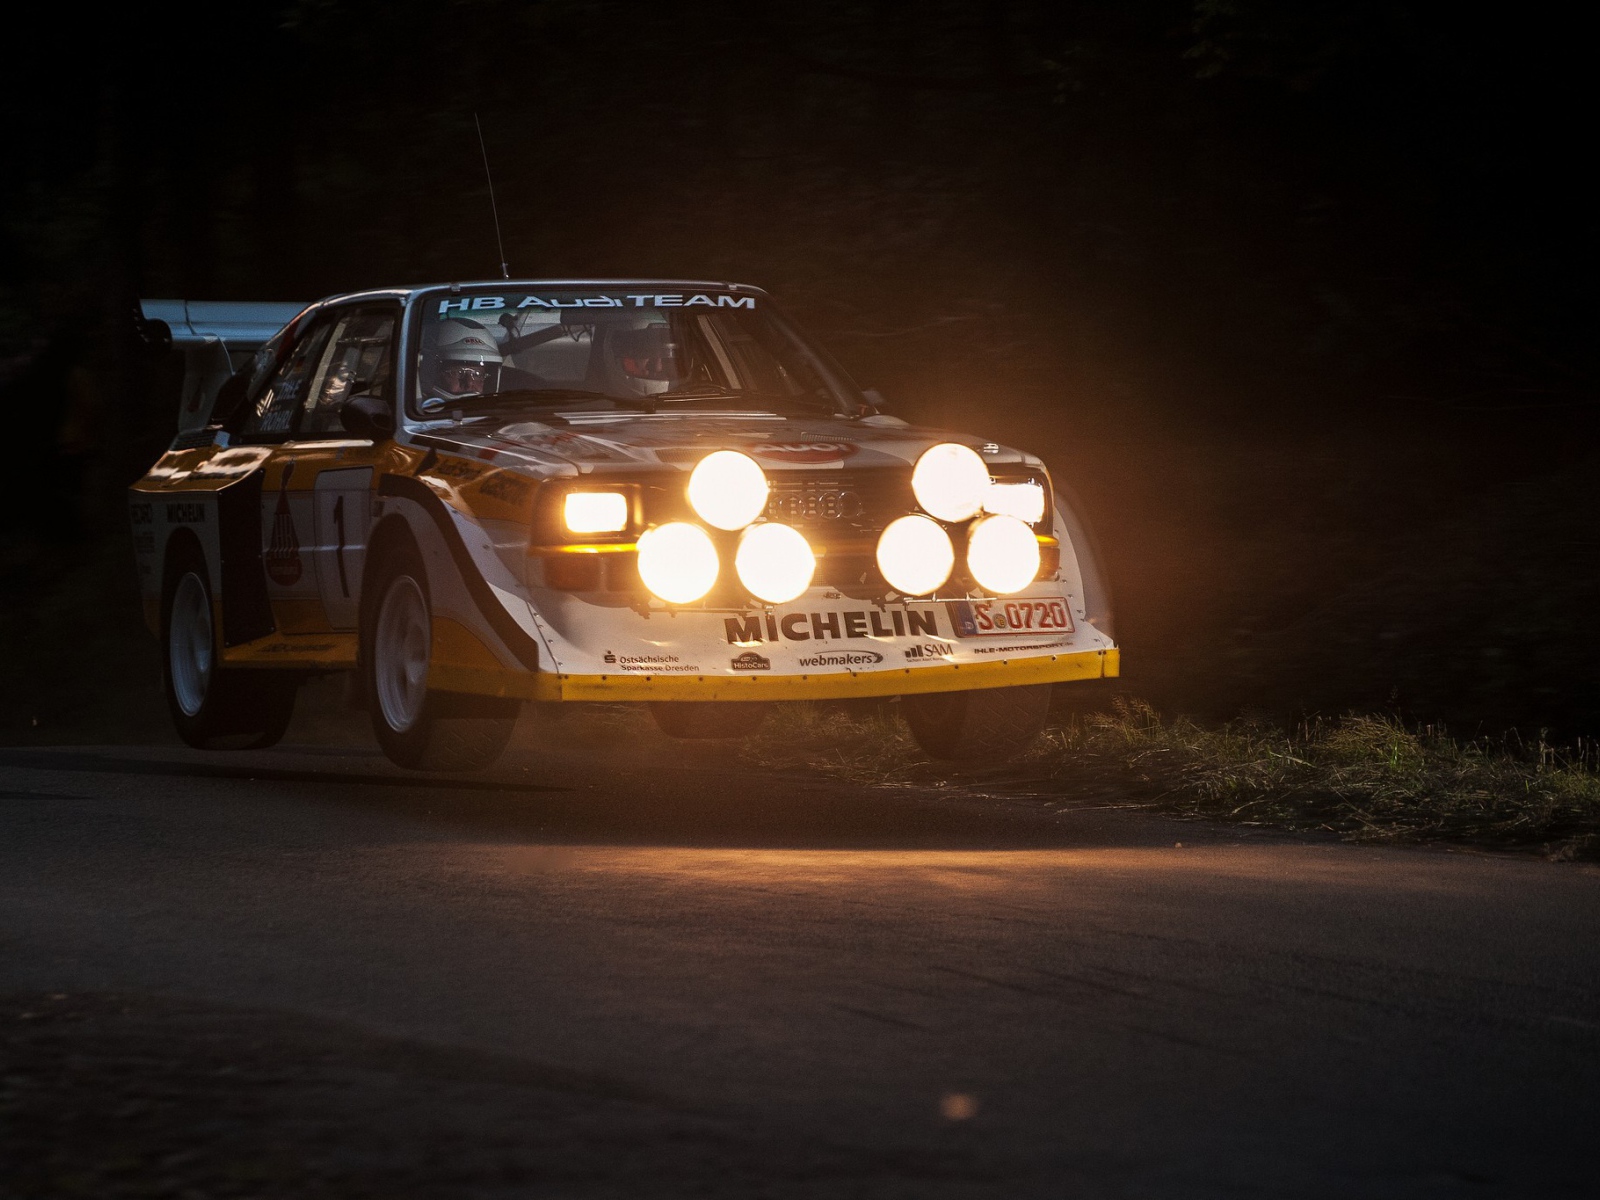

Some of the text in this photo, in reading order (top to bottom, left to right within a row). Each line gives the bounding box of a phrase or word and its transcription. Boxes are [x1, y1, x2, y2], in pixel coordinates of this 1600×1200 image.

[438, 297, 505, 314] HB
[627, 295, 755, 309] TEAM
[166, 503, 205, 523] MICHELIN
[333, 495, 350, 598] 1
[975, 603, 995, 631] S
[1004, 602, 1067, 630] 0720
[724, 610, 939, 644] MICHELIN
[619, 655, 679, 664] Ostsächsische
[799, 653, 874, 667] webmakers
